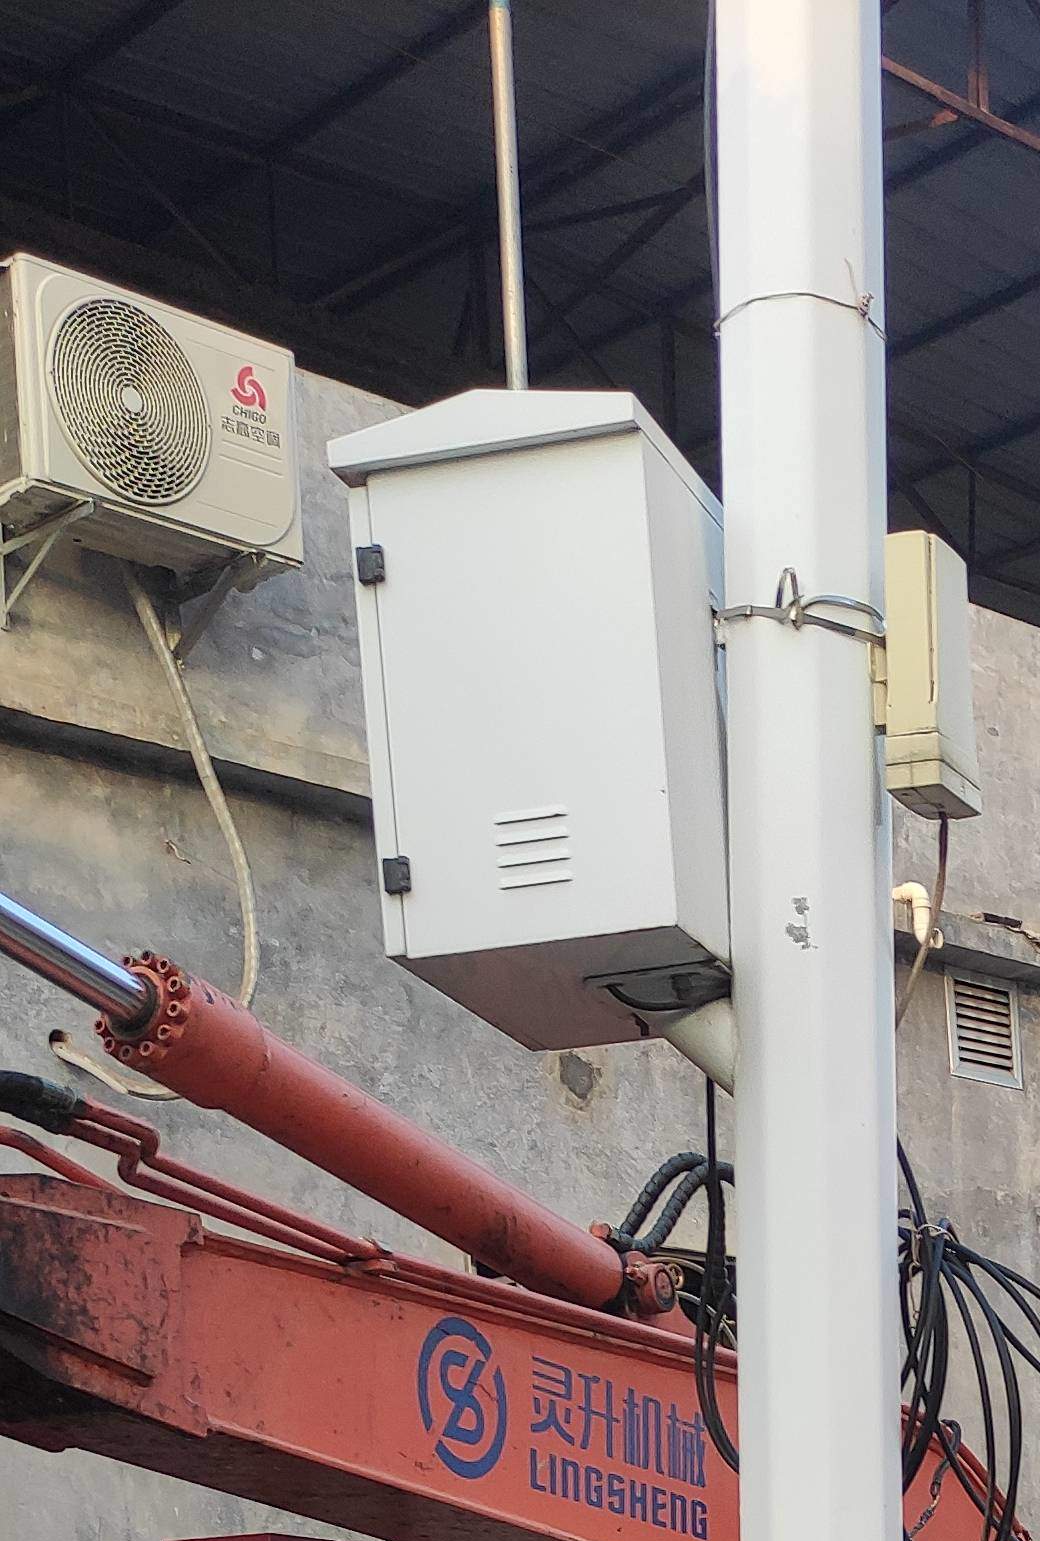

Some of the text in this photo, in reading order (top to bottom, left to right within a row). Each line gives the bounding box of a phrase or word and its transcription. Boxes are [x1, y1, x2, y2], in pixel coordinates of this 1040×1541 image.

[221, 414, 281, 449] 志高空调
[232, 405, 267, 424] CHIGO
[530, 1355, 708, 1488] 灵升机械
[529, 1447, 710, 1541] LINGSHENG
